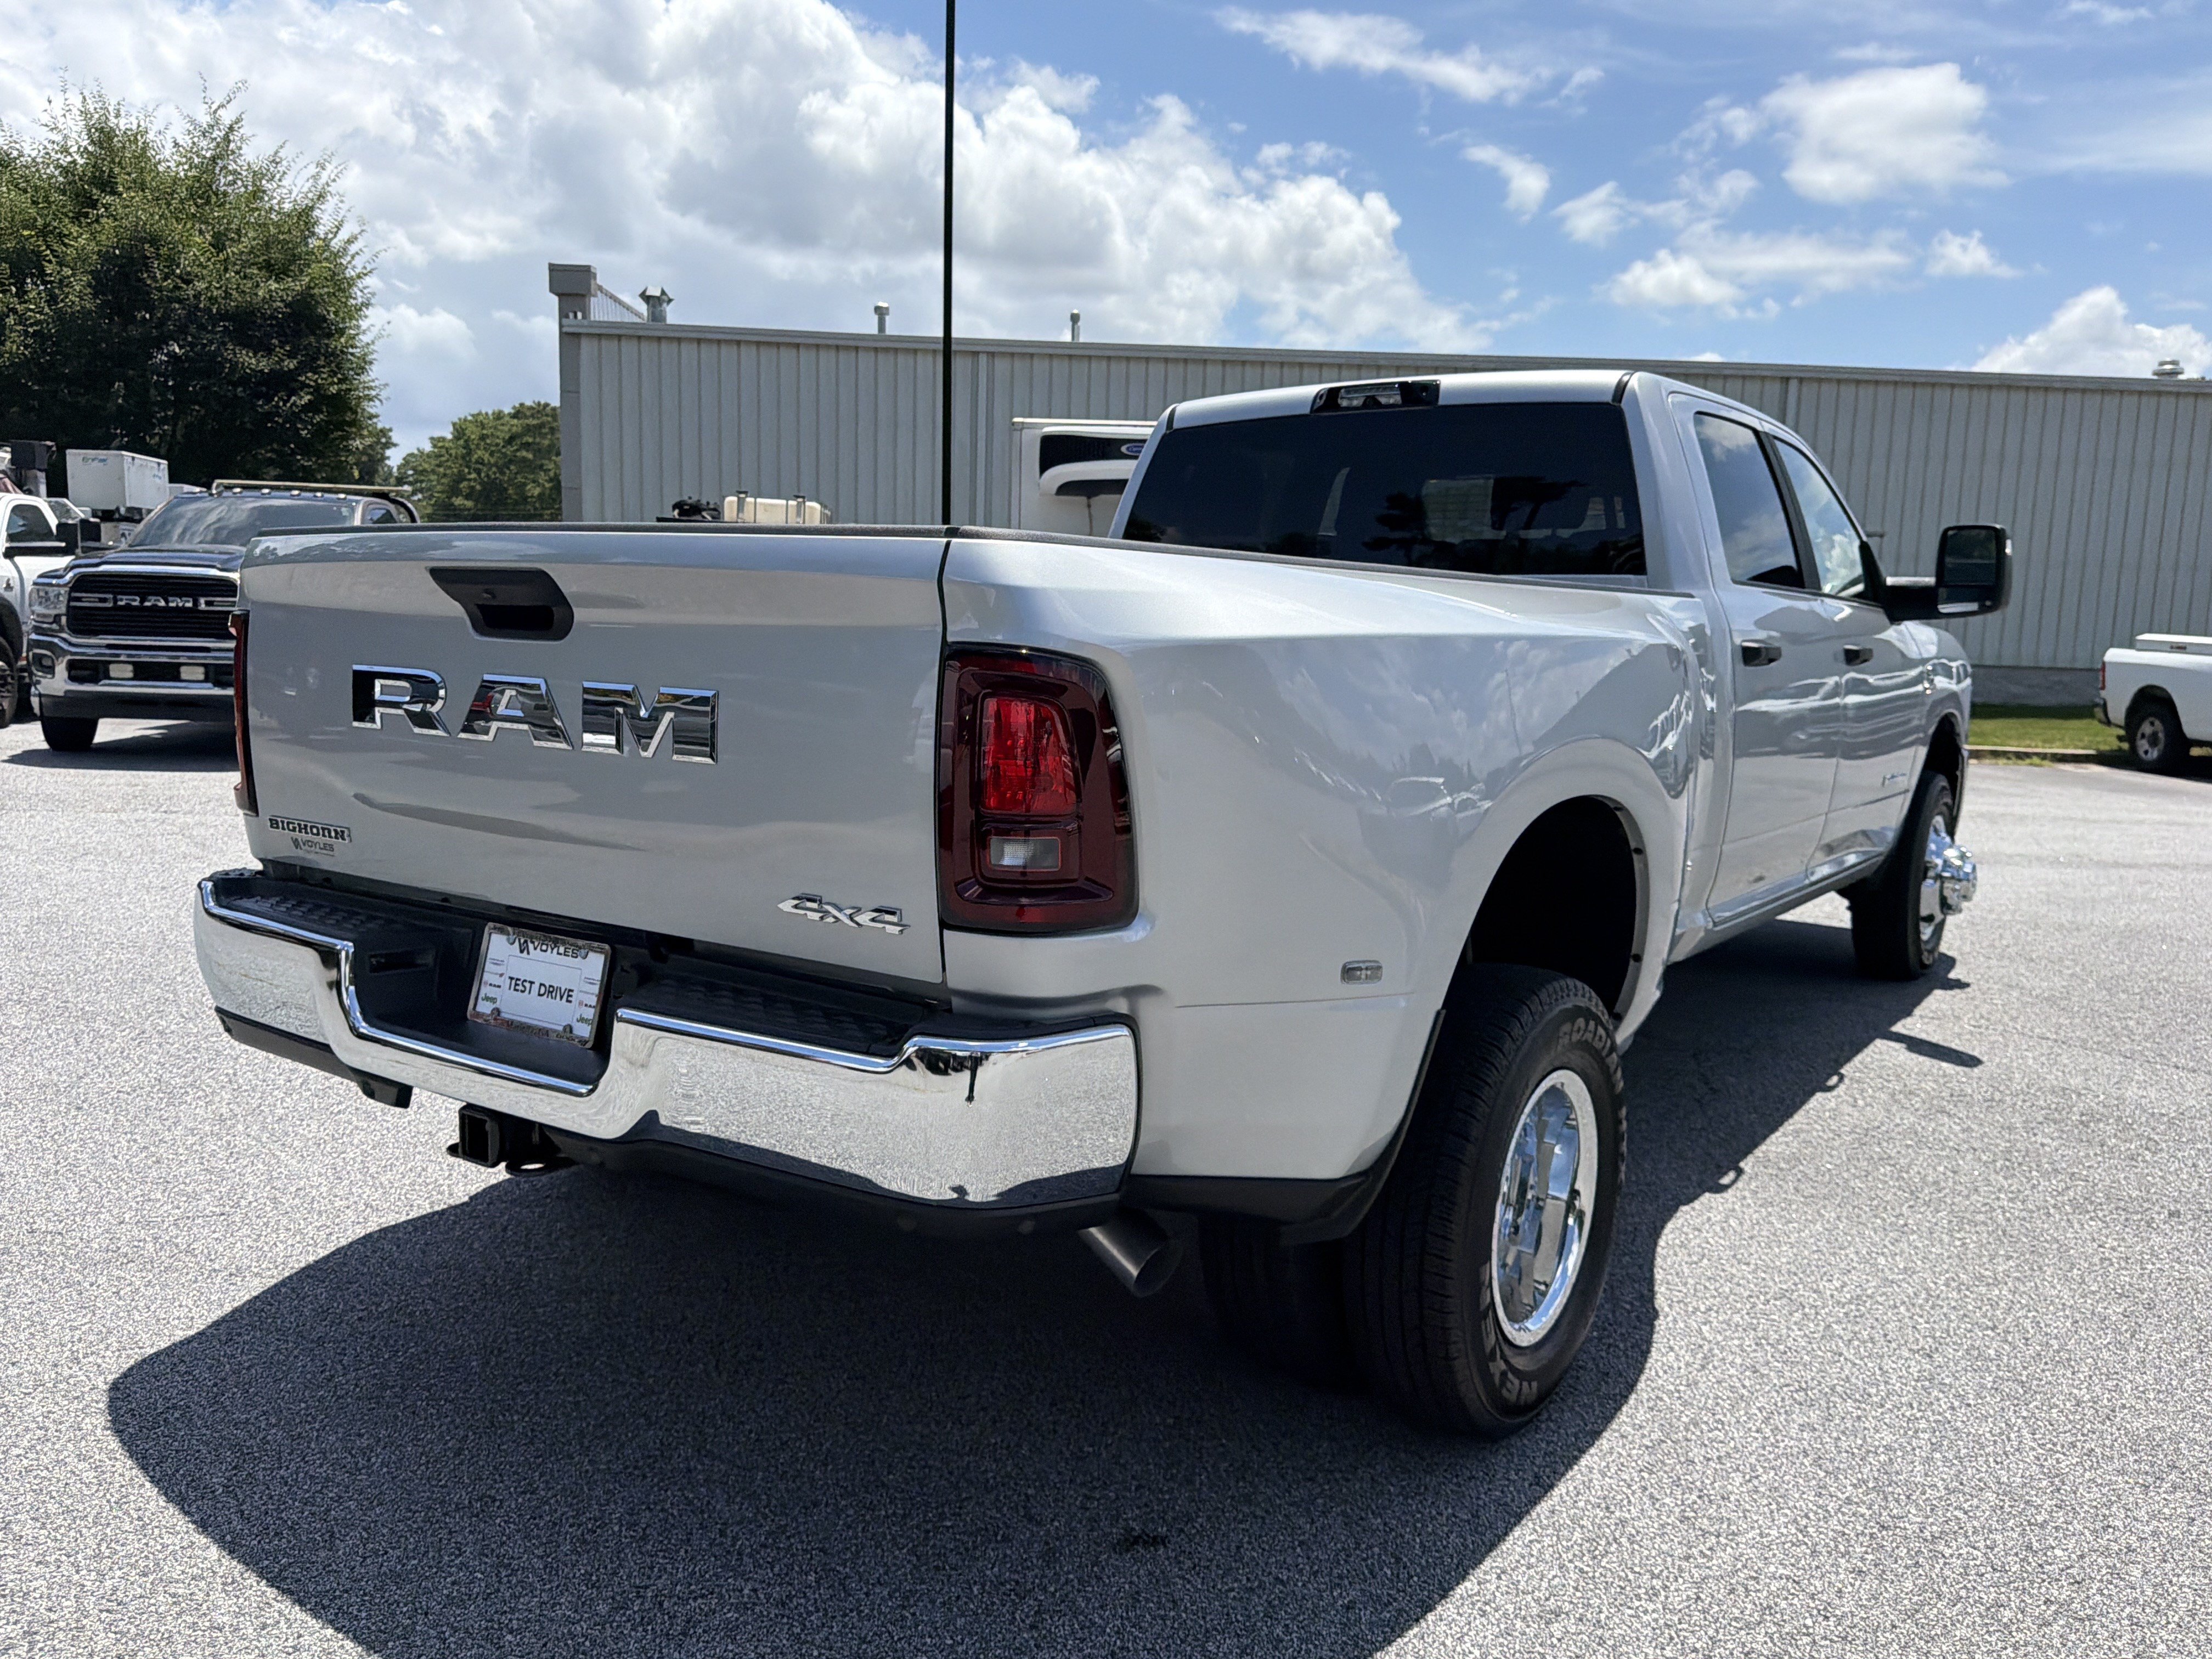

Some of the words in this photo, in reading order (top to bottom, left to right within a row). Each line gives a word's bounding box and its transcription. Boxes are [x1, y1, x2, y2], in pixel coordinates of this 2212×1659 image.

[117, 595, 193, 607] RAM
[352, 664, 719, 765] RAM
[268, 817, 347, 842] BIGHORN
[300, 838, 335, 852] VOYLES
[531, 940, 578, 959] VOYLES
[481, 992, 498, 1005] Jeep
[508, 976, 535, 995] TEST
[538, 983, 574, 1003] DRIVE
[1480, 1262, 1538, 1406] NEXEN
